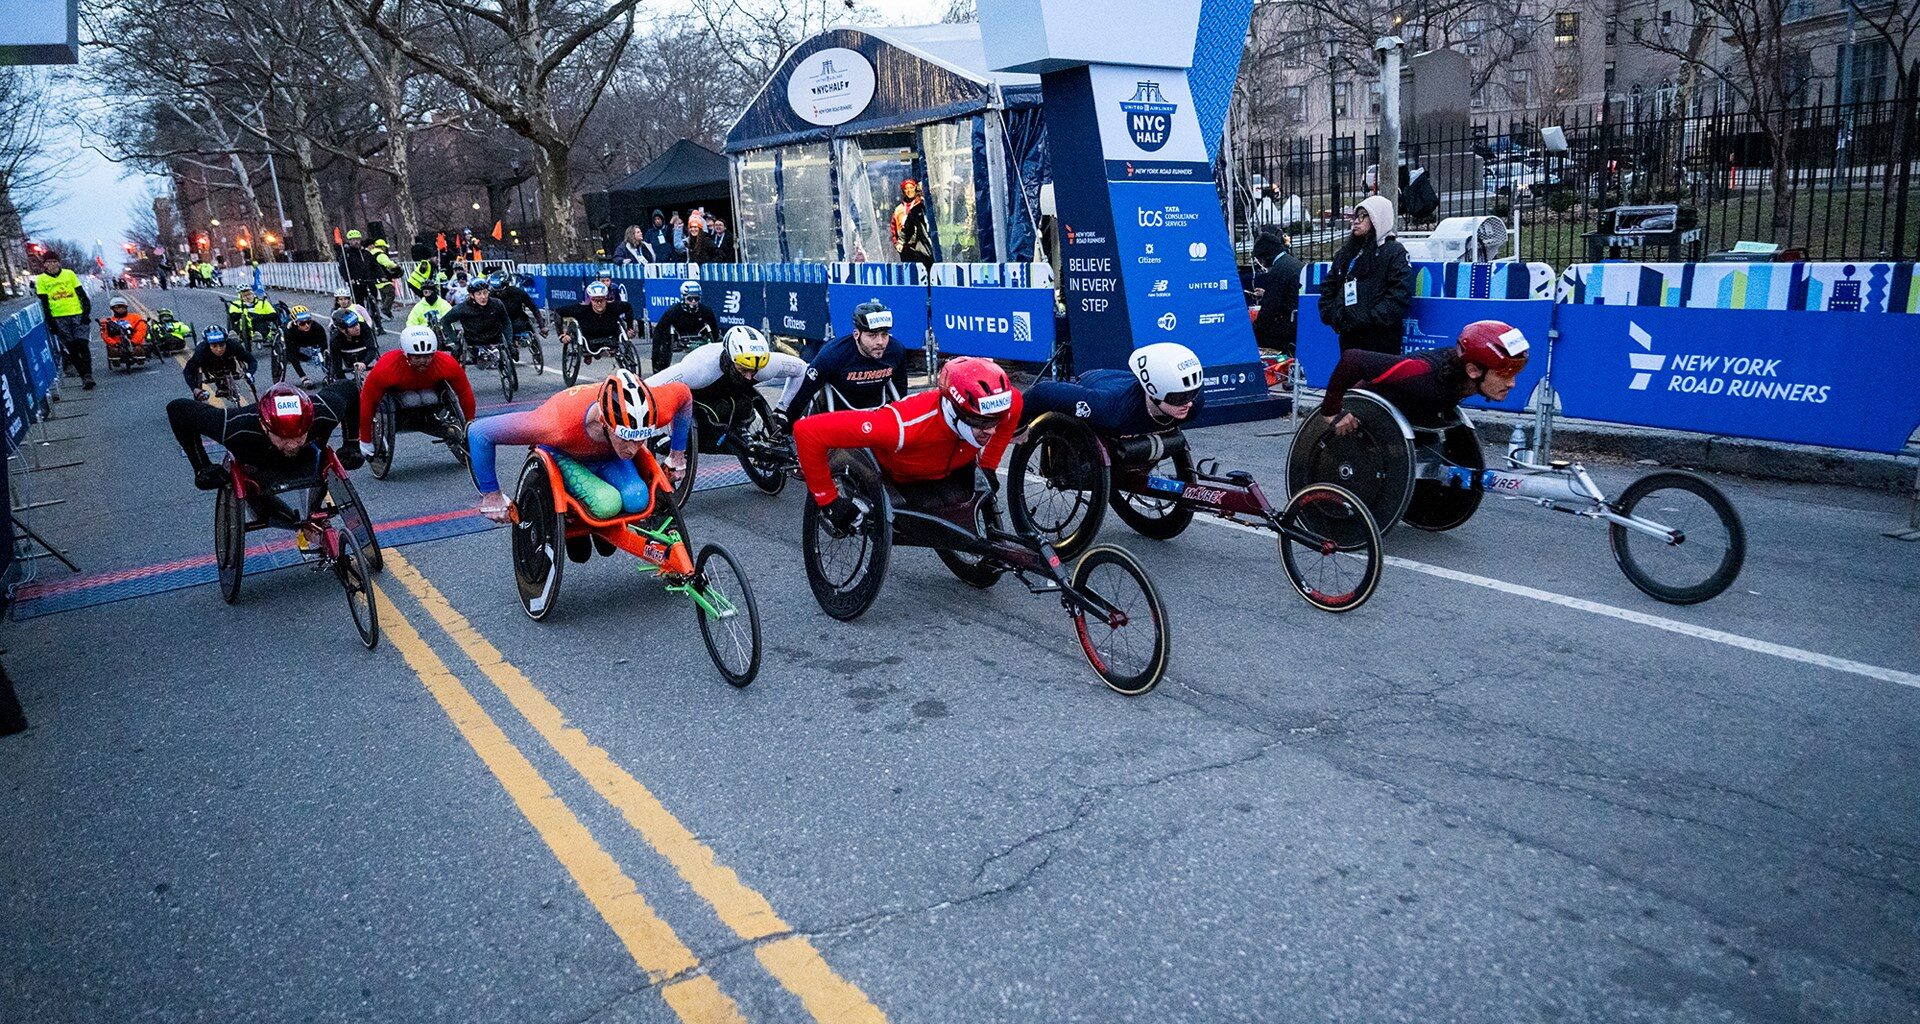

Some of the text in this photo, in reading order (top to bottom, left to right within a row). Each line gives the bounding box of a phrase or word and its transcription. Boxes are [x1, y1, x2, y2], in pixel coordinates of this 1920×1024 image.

[816, 81, 844, 95] NYC HALF
[1133, 115, 1165, 131] NYC
[1137, 132, 1163, 143] HALF
[1138, 206, 1163, 227] tcs
[1069, 258, 1111, 272] BELIEVE
[1138, 256, 1162, 264] Citizens
[1069, 278, 1117, 292] IN EVERY
[1188, 282, 1219, 290] UNITED
[1081, 298, 1109, 312] STEP
[728, 316, 745, 325] balance
[783, 316, 806, 330] Citizens
[945, 314, 1009, 333] UNITED
[1200, 313, 1225, 325] ESPN
[1671, 354, 1781, 377] NEW YORK
[846, 368, 893, 381] ILLINOIS
[1668, 375, 1831, 404] ROAD RUNNERS
[277, 401, 299, 409] GARIC
[619, 428, 652, 438] SCHIPPER
